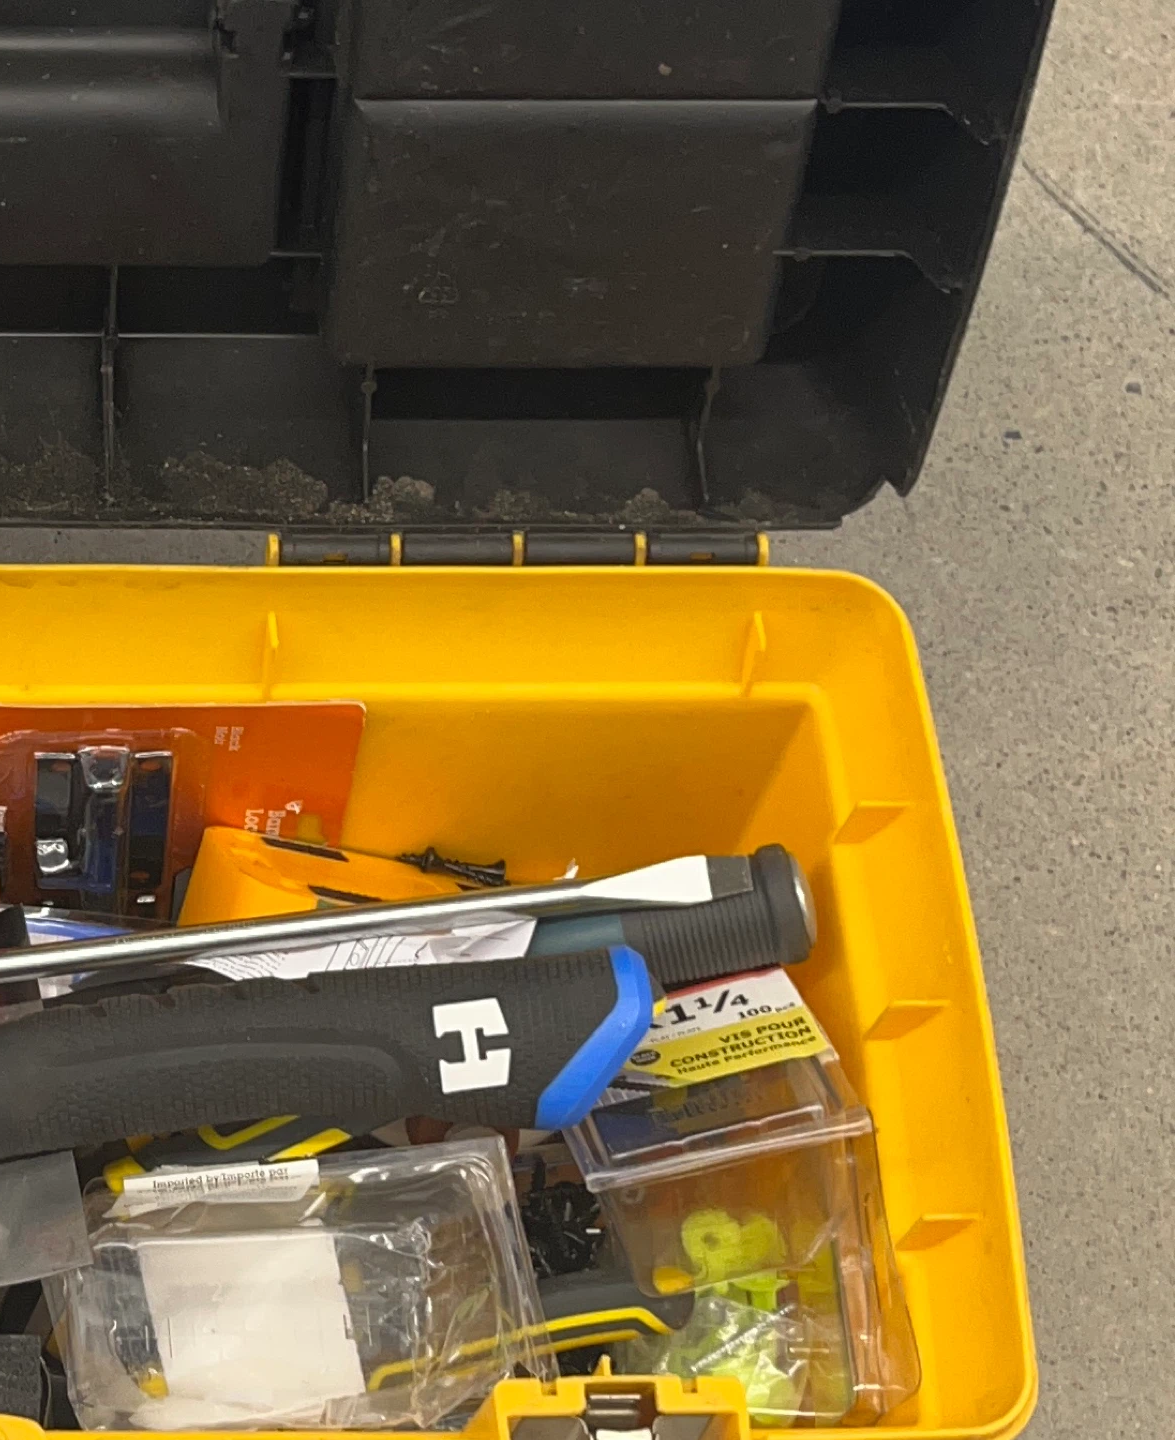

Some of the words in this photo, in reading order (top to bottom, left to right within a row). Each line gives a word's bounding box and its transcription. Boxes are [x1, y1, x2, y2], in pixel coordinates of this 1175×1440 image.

[738, 1004, 772, 1019] 100
[719, 1029, 750, 1043] VIS
[756, 1016, 807, 1034] POUR
[669, 1025, 813, 1069] CONSTRUCTION
[677, 1059, 721, 1076] Haute
[723, 1035, 817, 1063] Performance
